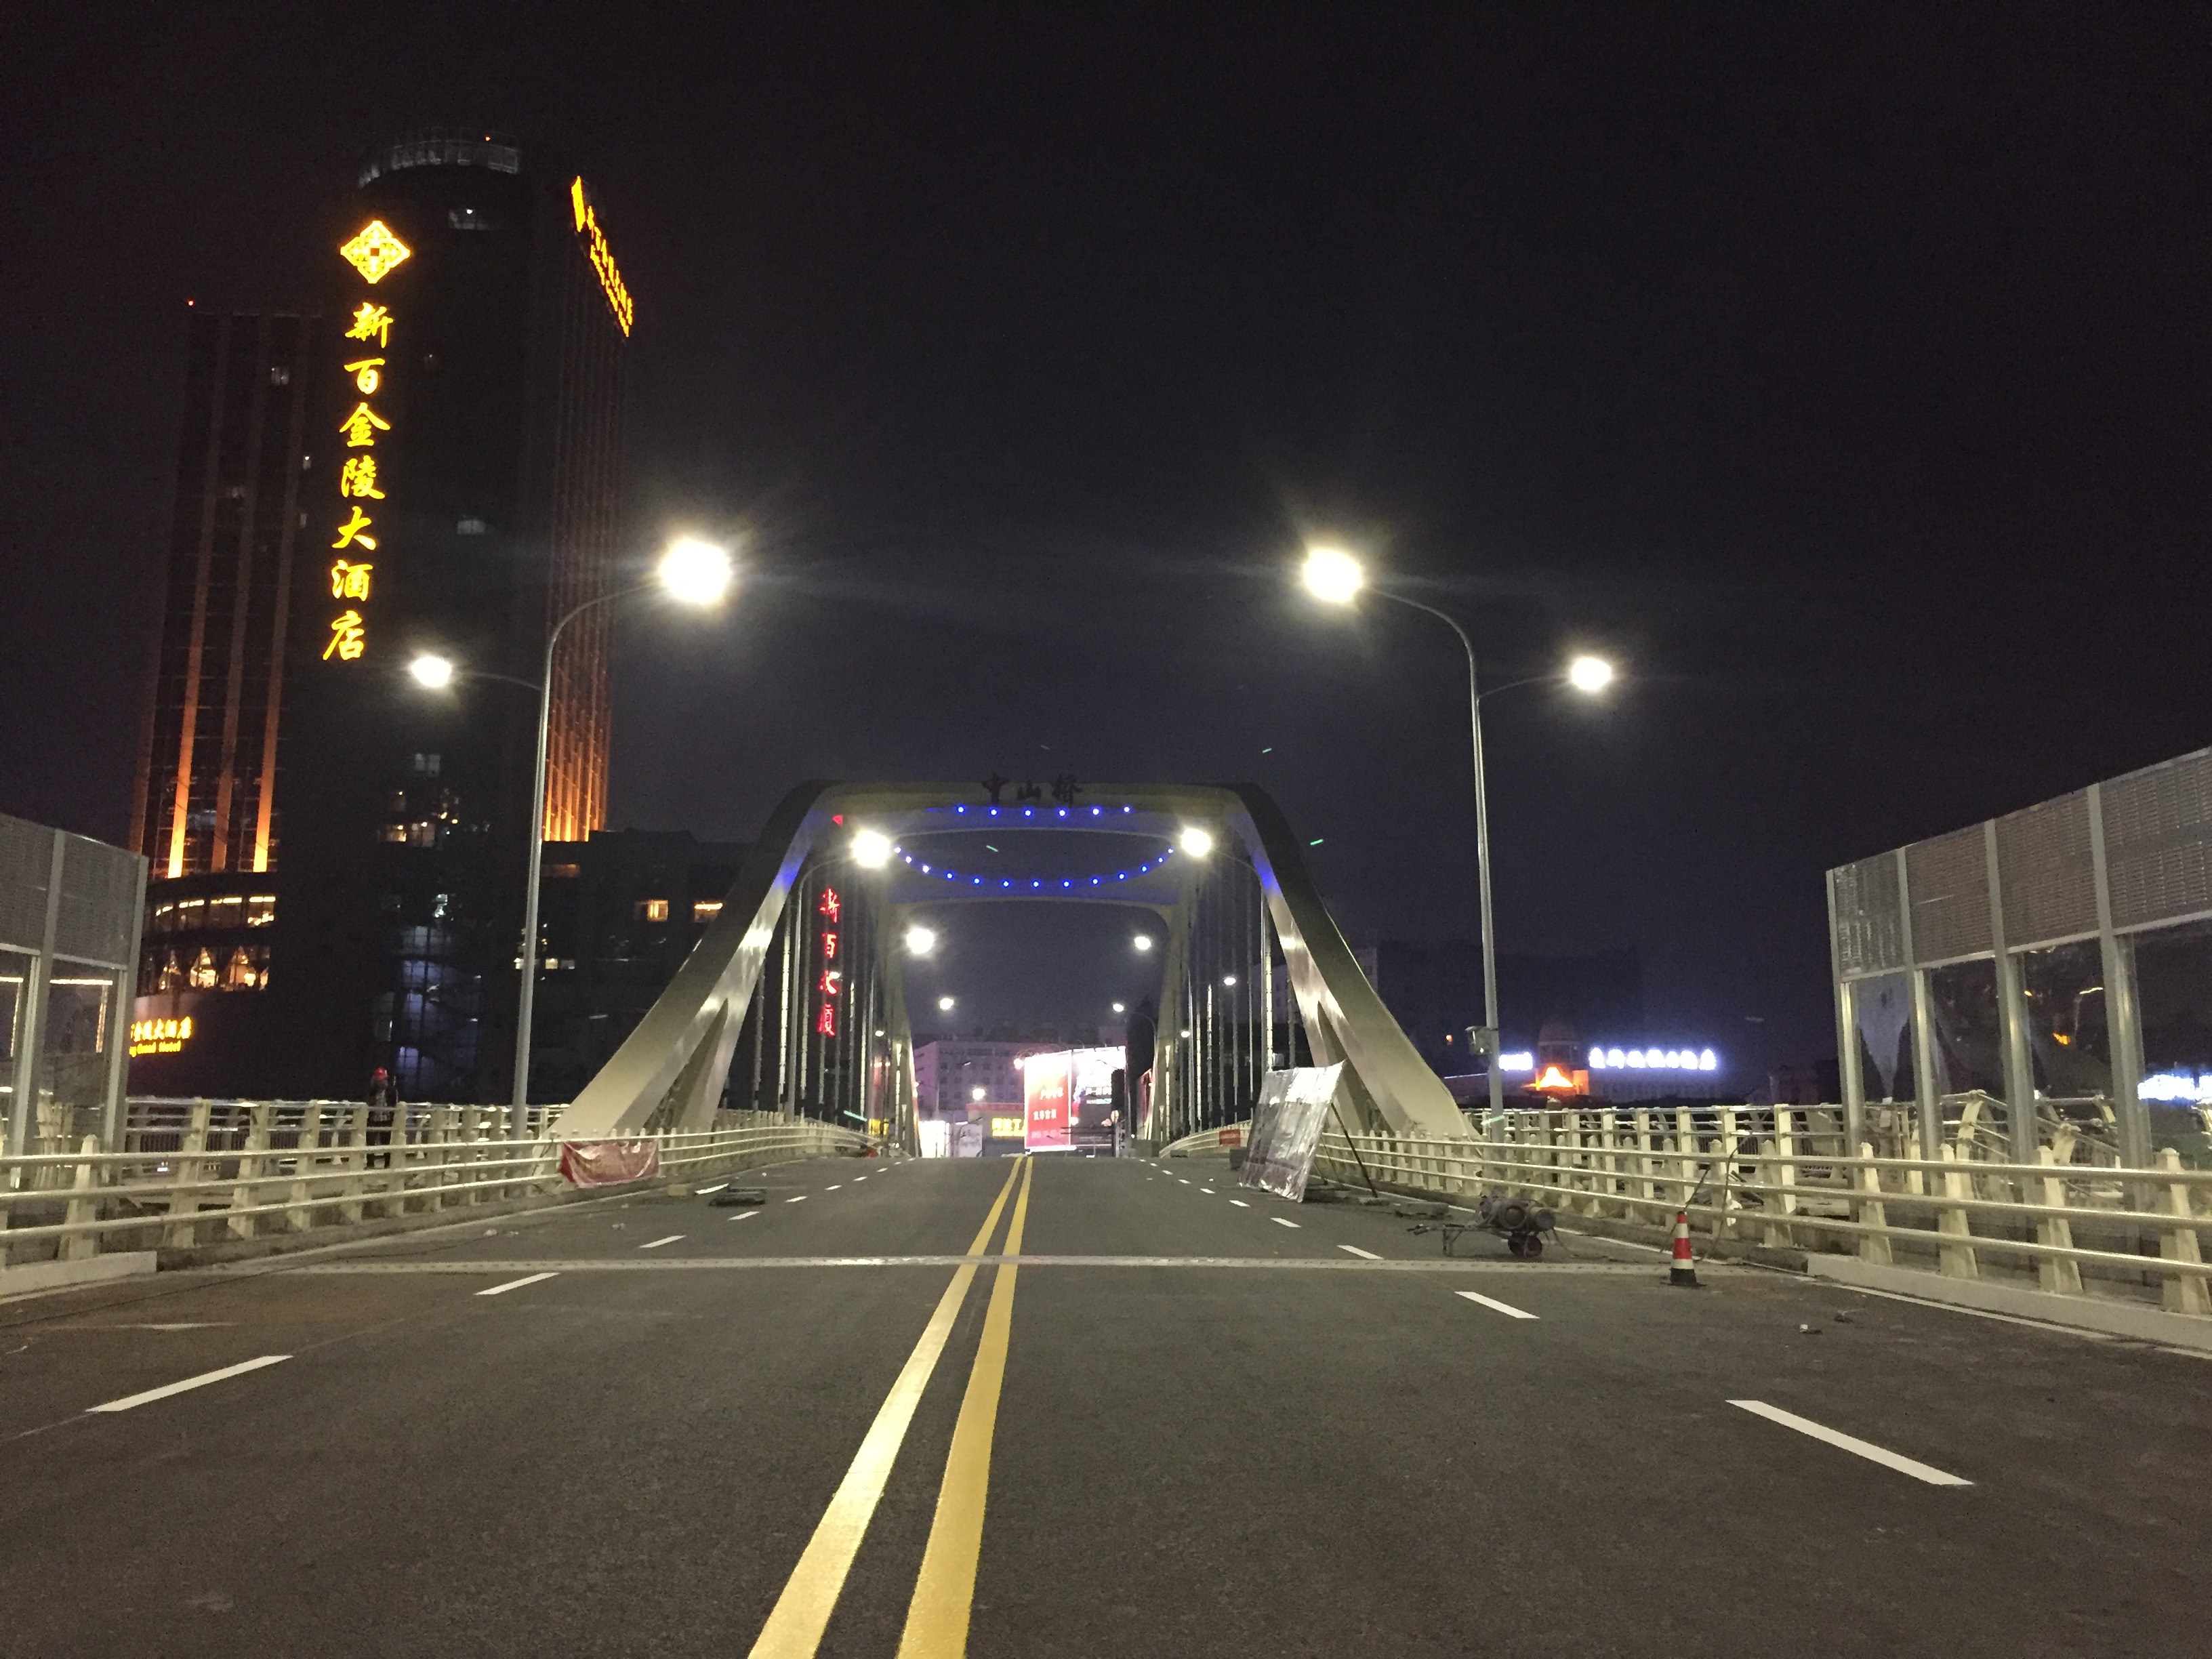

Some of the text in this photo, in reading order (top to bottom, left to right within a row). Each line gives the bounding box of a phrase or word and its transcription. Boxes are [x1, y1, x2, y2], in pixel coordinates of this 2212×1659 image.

[323, 301, 394, 661] 新百金陵大酒店
